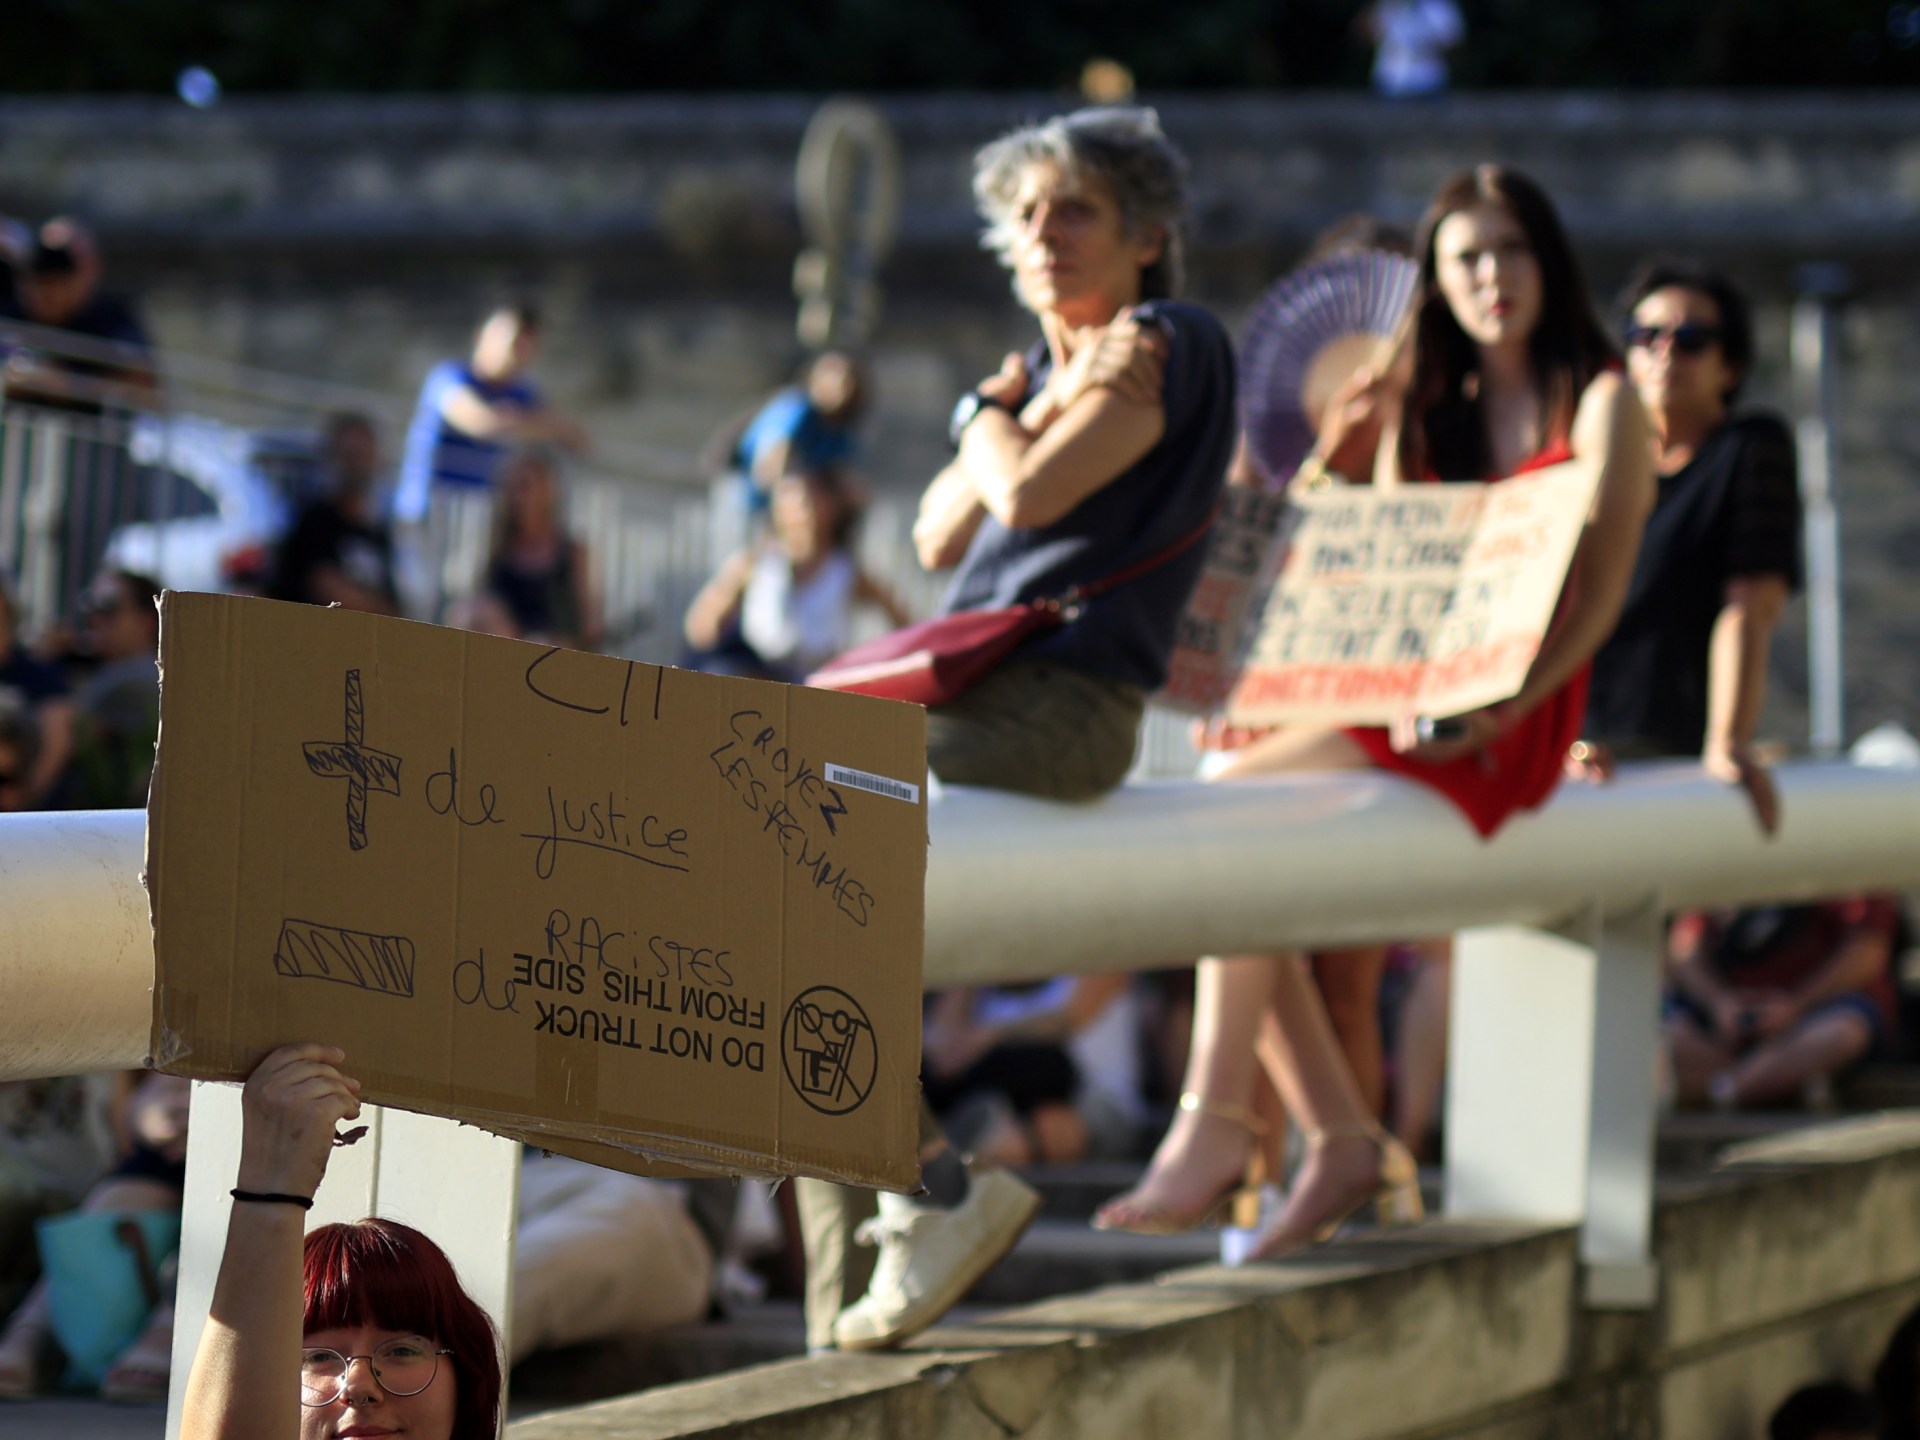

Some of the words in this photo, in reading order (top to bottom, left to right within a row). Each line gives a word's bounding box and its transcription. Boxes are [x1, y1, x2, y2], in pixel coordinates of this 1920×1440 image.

[710, 741, 767, 812] LES
[425, 747, 505, 826] de
[536, 752, 690, 880] justice
[451, 947, 521, 1014] de
[512, 952, 586, 996] SIDE
[603, 970, 673, 1013] THIS
[534, 999, 643, 1050] TRUCK
[680, 984, 766, 1031] FROM
[649, 1023, 713, 1063] NOT
[721, 1036, 765, 1073] DO
